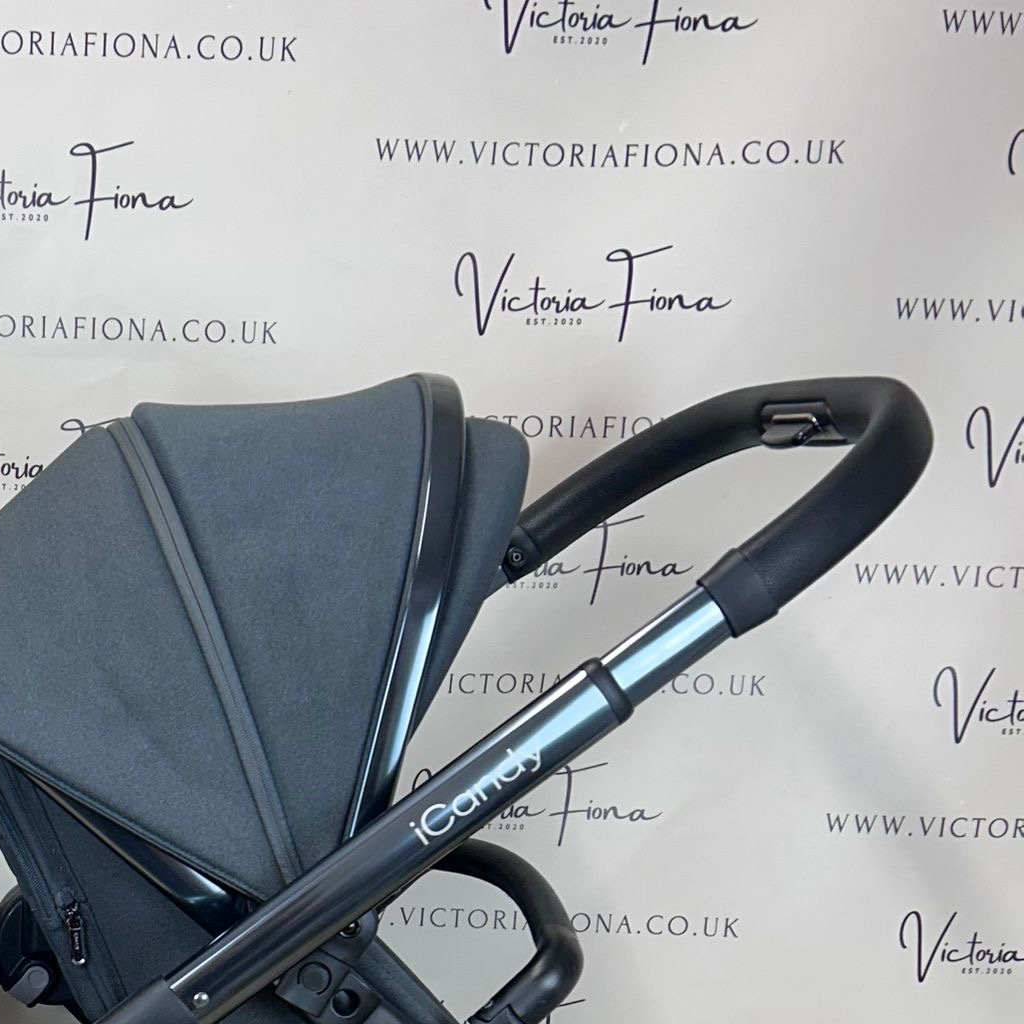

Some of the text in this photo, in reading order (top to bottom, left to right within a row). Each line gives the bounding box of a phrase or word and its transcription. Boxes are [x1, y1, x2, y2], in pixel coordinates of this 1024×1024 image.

[487, 0, 631, 54] Victoria
[553, 36, 608, 45] EST.2020
[70, 141, 193, 241] Fiona
[376, 138, 846, 168] WWW.VICTORIAFIONA.CO.UK
[455, 245, 732, 342] Victoria Fiona
[526, 317, 582, 326] EST.2020
[583, 515, 694, 605] Fiona
[408, 746, 543, 846] iCandy
[550, 762, 662, 847] Fiona
[899, 910, 1024, 983] Victoria
